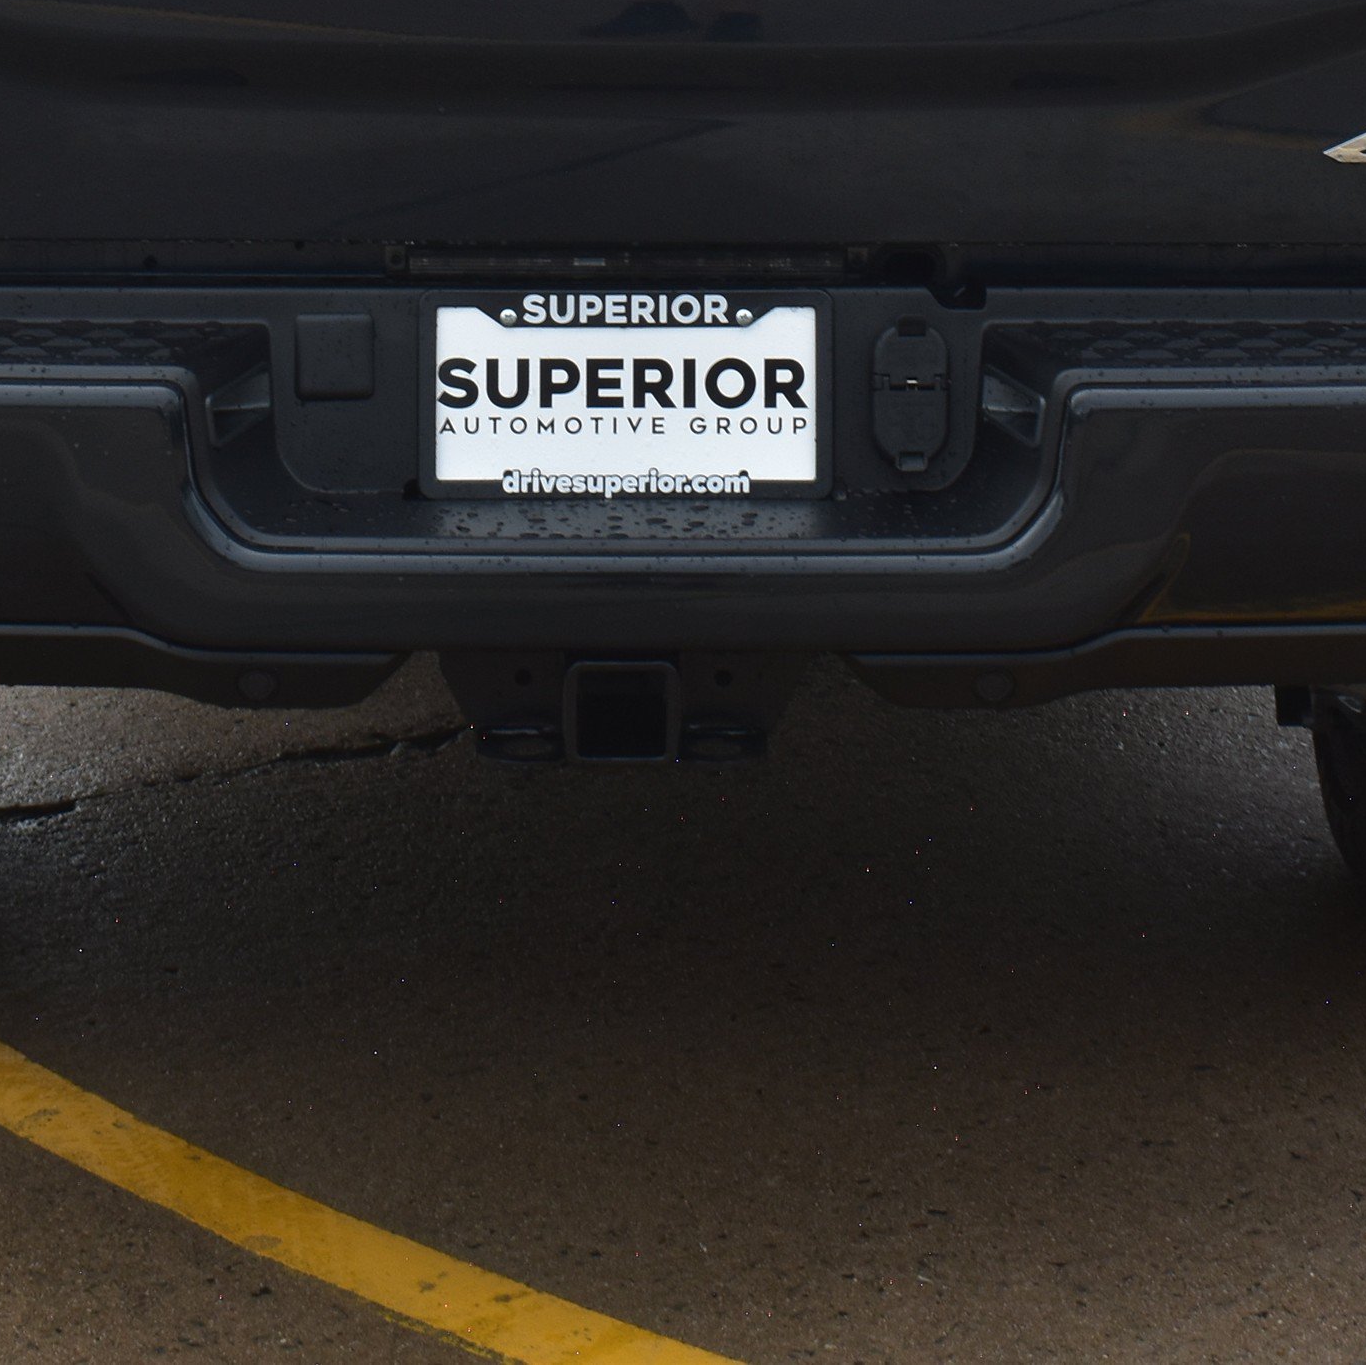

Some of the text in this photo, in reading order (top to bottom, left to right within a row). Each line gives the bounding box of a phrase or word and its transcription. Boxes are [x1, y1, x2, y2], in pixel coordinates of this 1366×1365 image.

[522, 293, 729, 326] SUPERIOR
[437, 357, 809, 409] SUPERIOR
[439, 417, 808, 435] AUTOMOTIVE GROUP
[502, 468, 750, 498] drivesuperior.com
